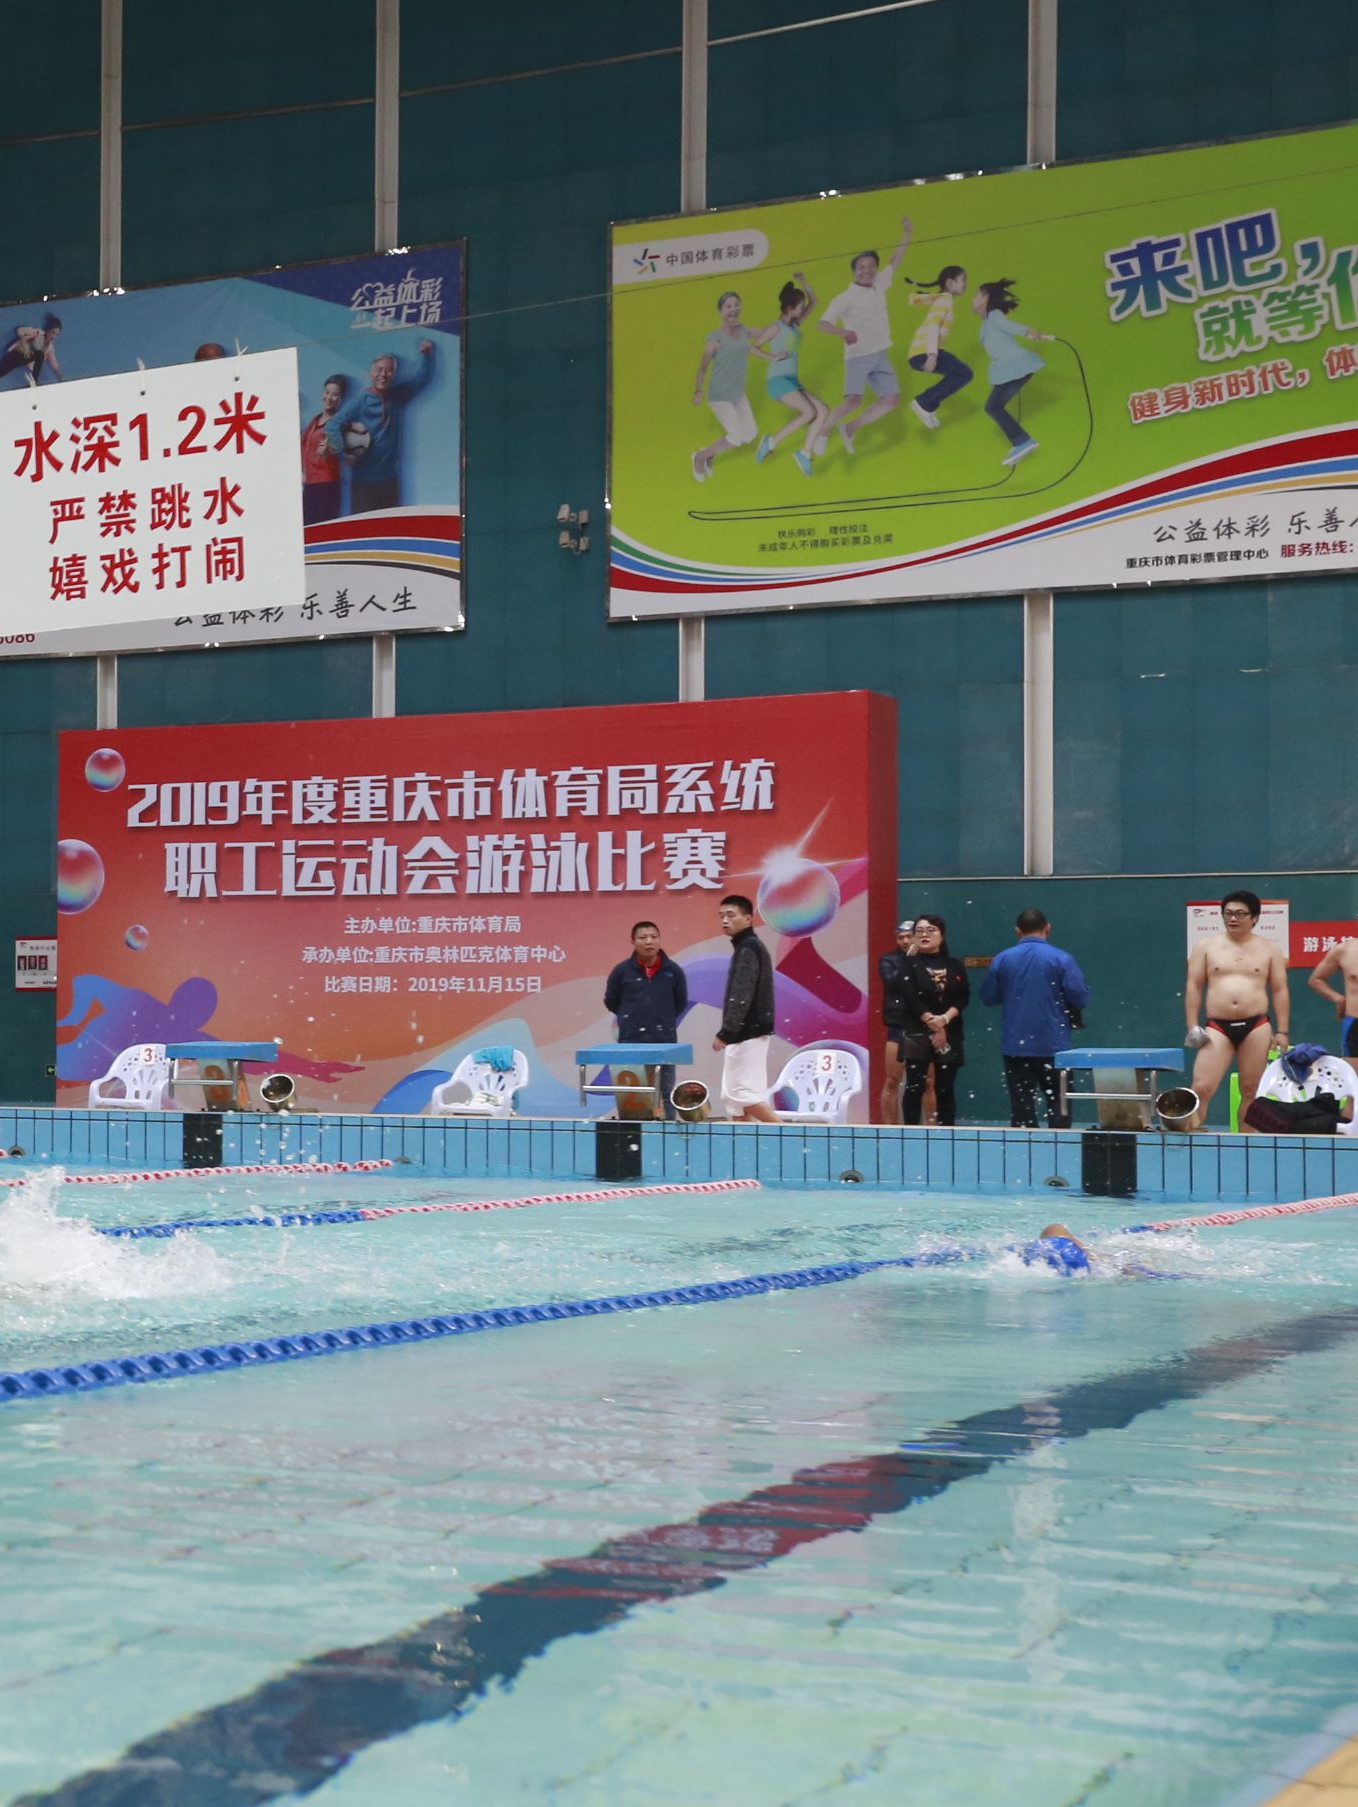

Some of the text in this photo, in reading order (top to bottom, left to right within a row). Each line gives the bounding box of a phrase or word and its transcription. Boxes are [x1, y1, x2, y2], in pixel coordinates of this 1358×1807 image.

[666, 243, 755, 267] 中国体育彩票
[350, 268, 444, 311] 公益体彩
[13, 391, 268, 483] 水深1.2米
[49, 476, 245, 544] 严禁跳水
[758, 533, 894, 552] 未成年人不得购买彩票及兑奖
[778, 527, 817, 539] 快乐购彩
[1153, 514, 1270, 543] 公益体彩
[49, 536, 245, 601] 嬉戏打闹
[1126, 548, 1269, 569] 重庆市体育彩票管理中心
[300, 586, 417, 620] 乐善人生
[127, 758, 775, 828] 2019年度重庆市体育局系统
[164, 828, 727, 898] 职工运动会游泳比赛
[144, 1048, 153, 1062] 3
[822, 1055, 832, 1071] 3
